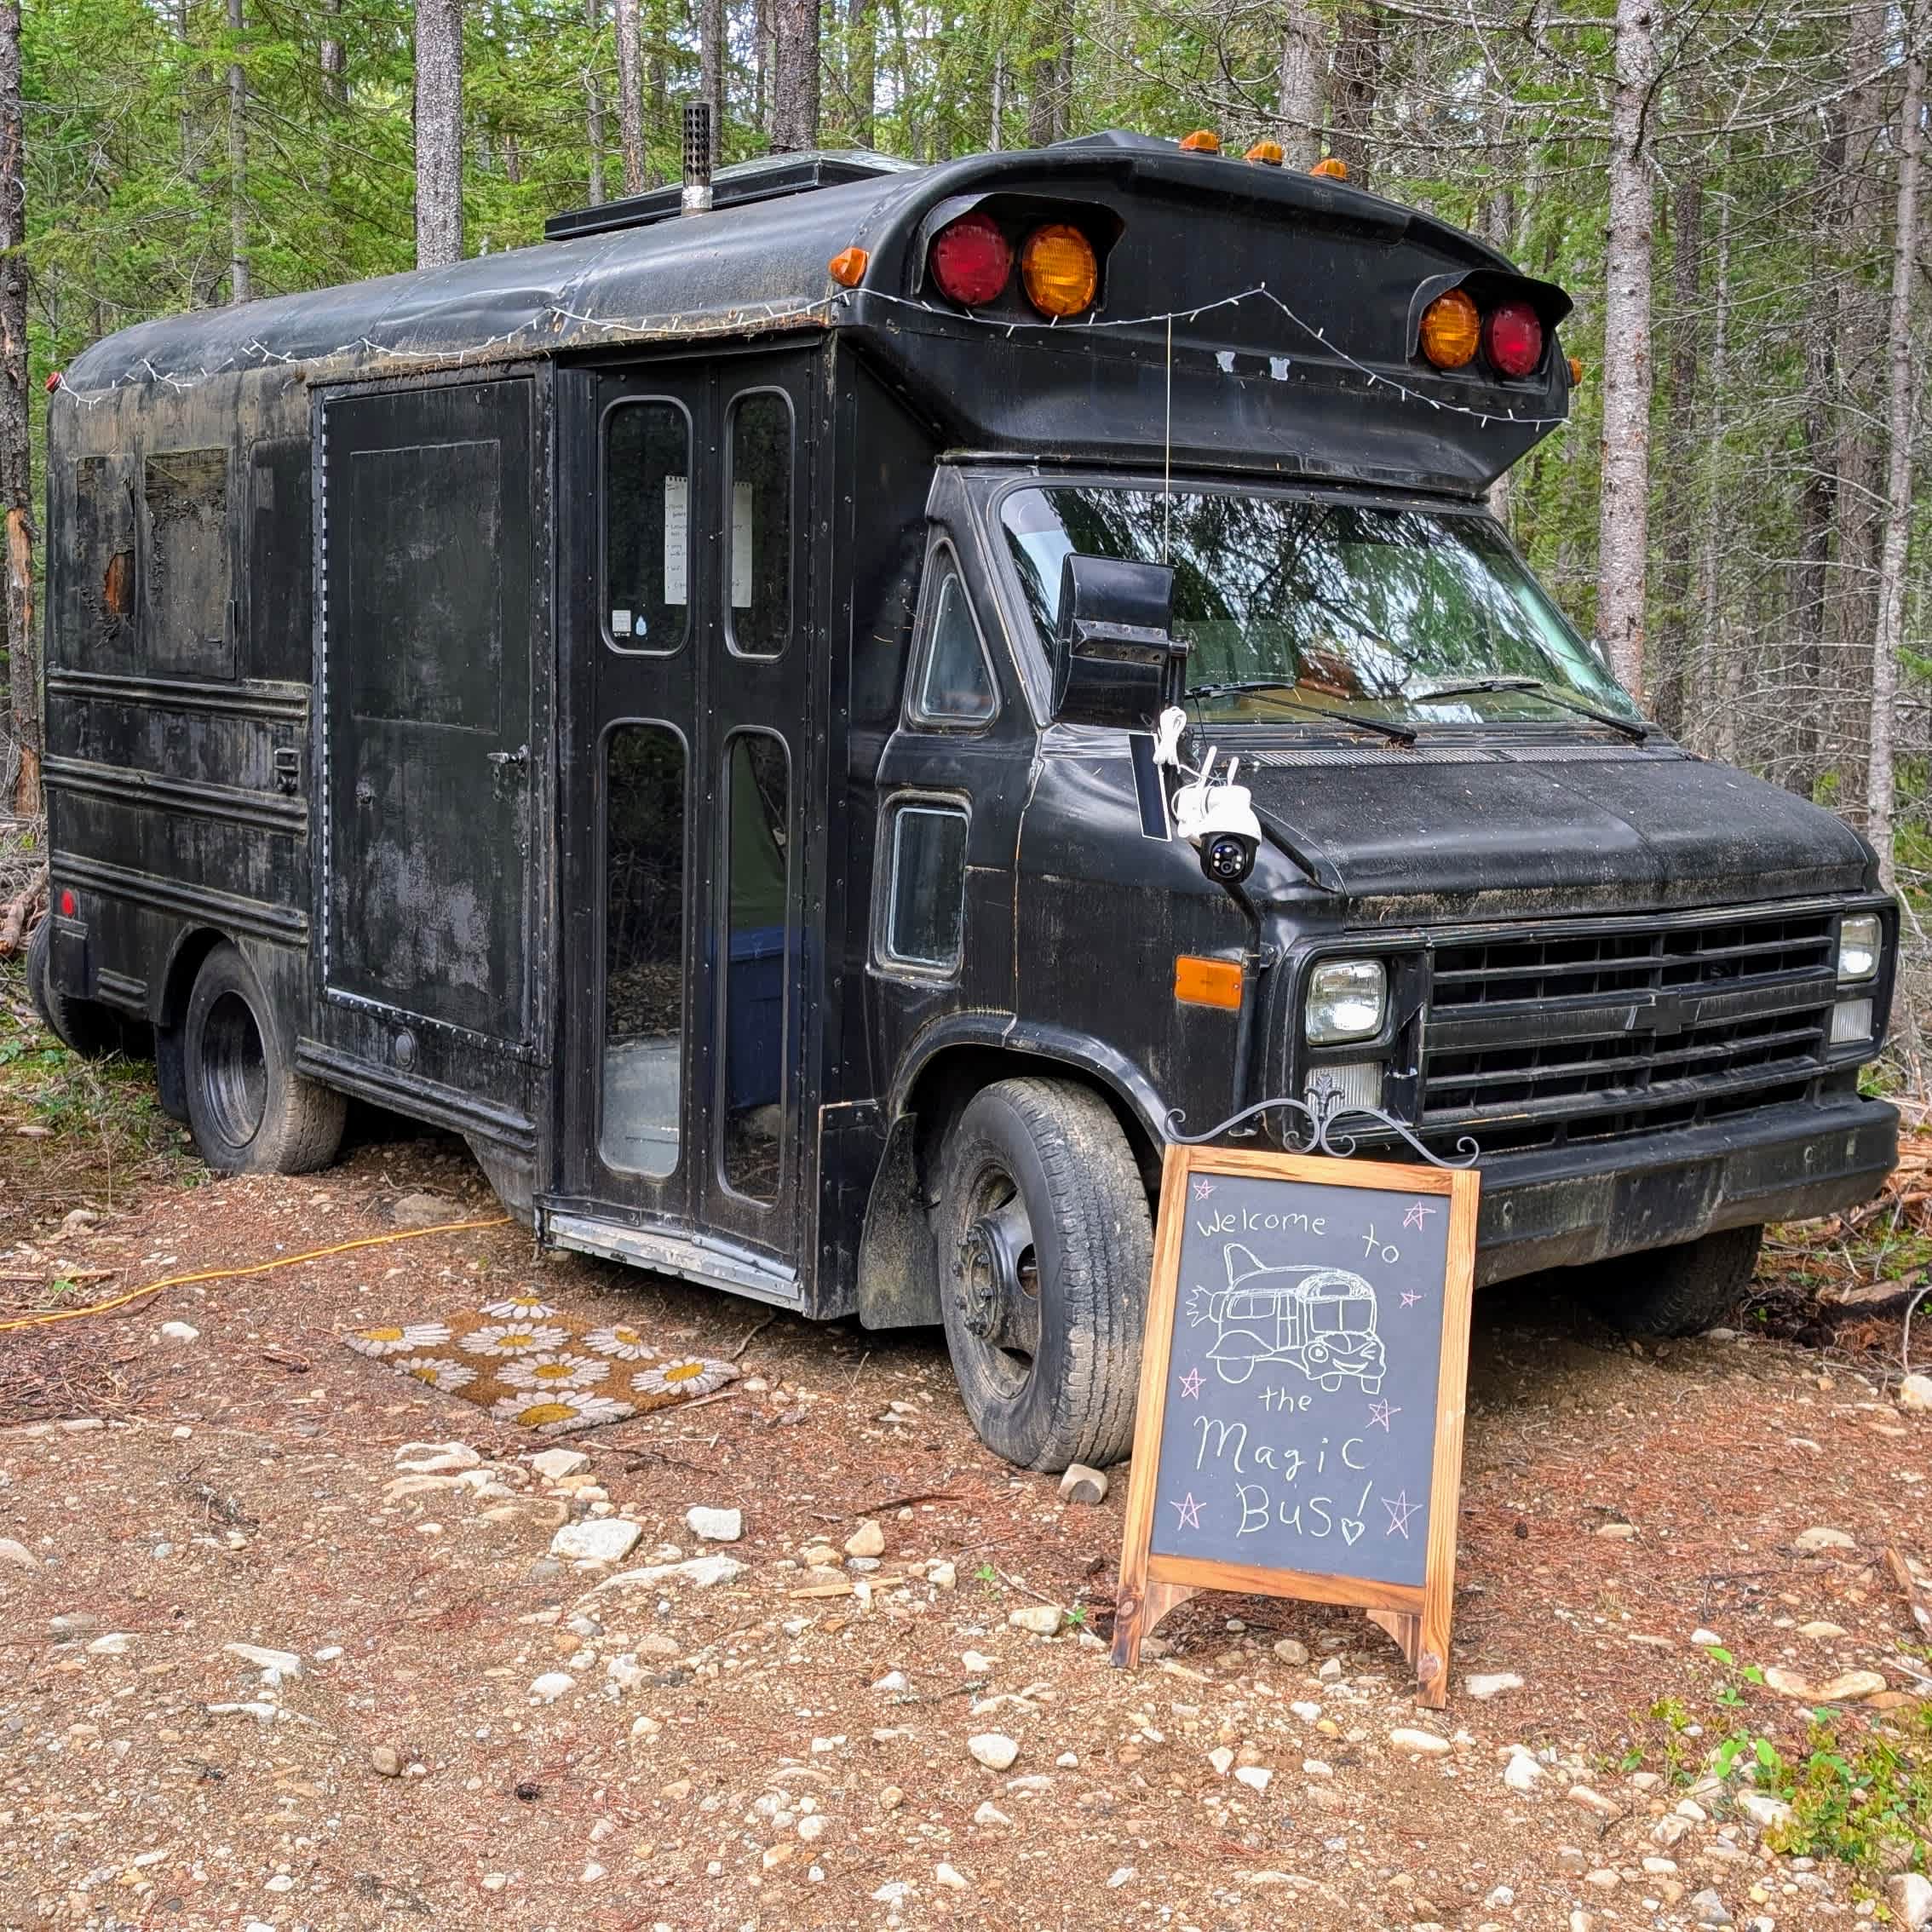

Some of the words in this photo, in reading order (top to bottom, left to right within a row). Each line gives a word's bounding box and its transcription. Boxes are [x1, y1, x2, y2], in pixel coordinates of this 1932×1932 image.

[1196, 1208, 1326, 1236] Welcome
[1362, 1223, 1400, 1263] to
[1258, 1386, 1312, 1412] the
[1193, 1415, 1371, 1481] Magic
